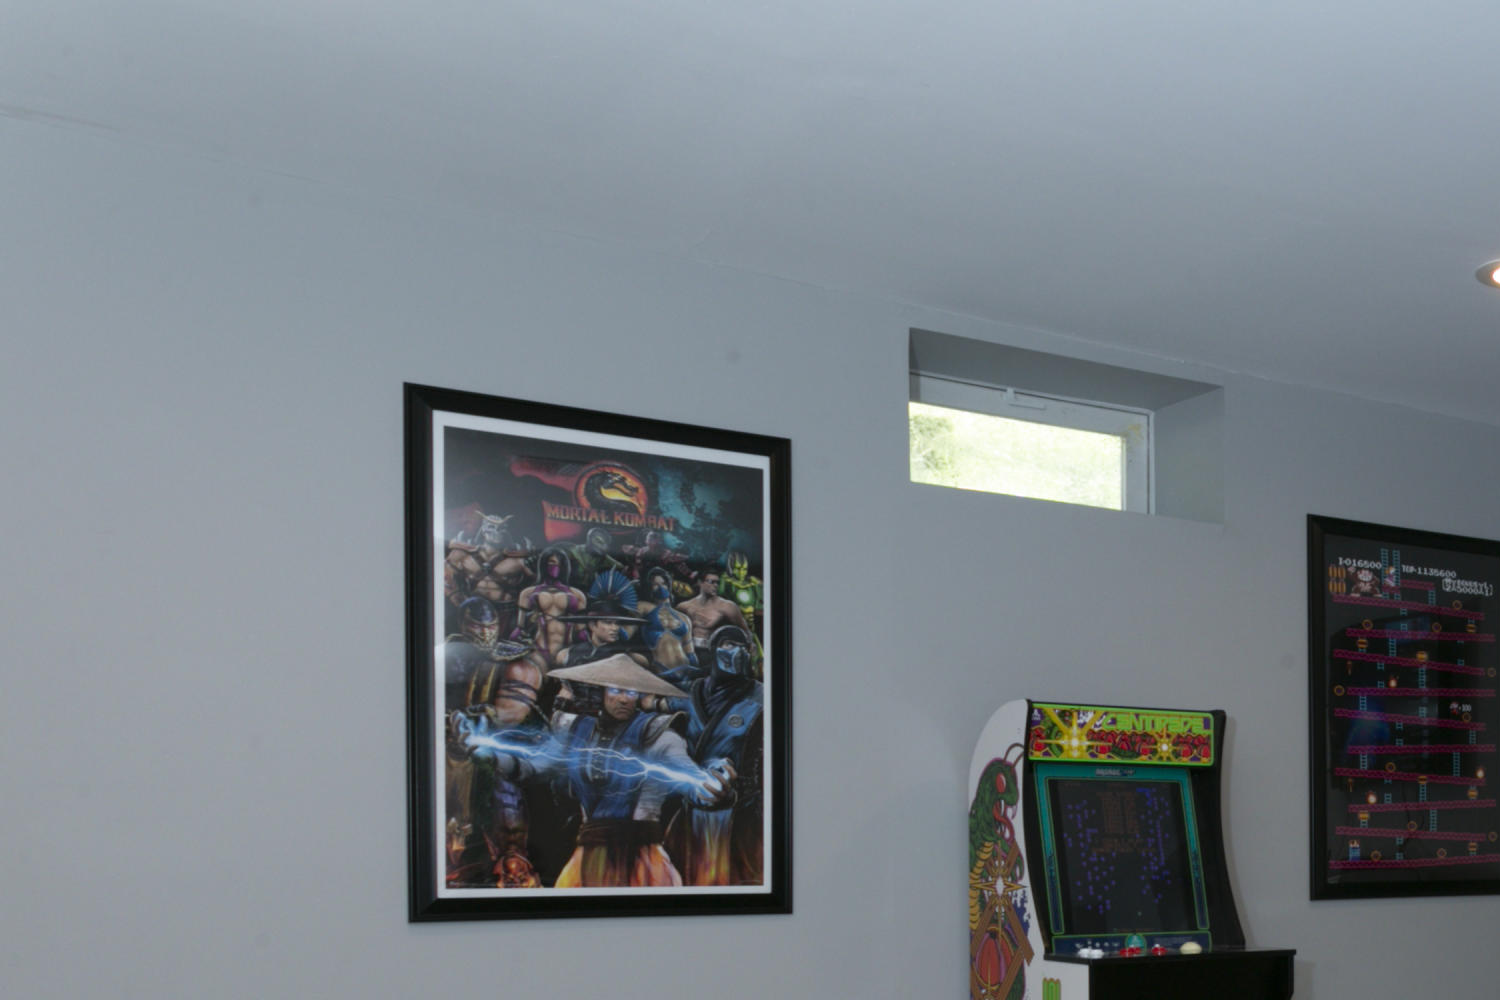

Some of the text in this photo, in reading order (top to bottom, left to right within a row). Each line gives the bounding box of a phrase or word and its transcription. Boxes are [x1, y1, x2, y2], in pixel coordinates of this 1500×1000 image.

[547, 504, 675, 532] MORTAL KOMBAT
[1101, 713, 1206, 735] CENTIPEDE
